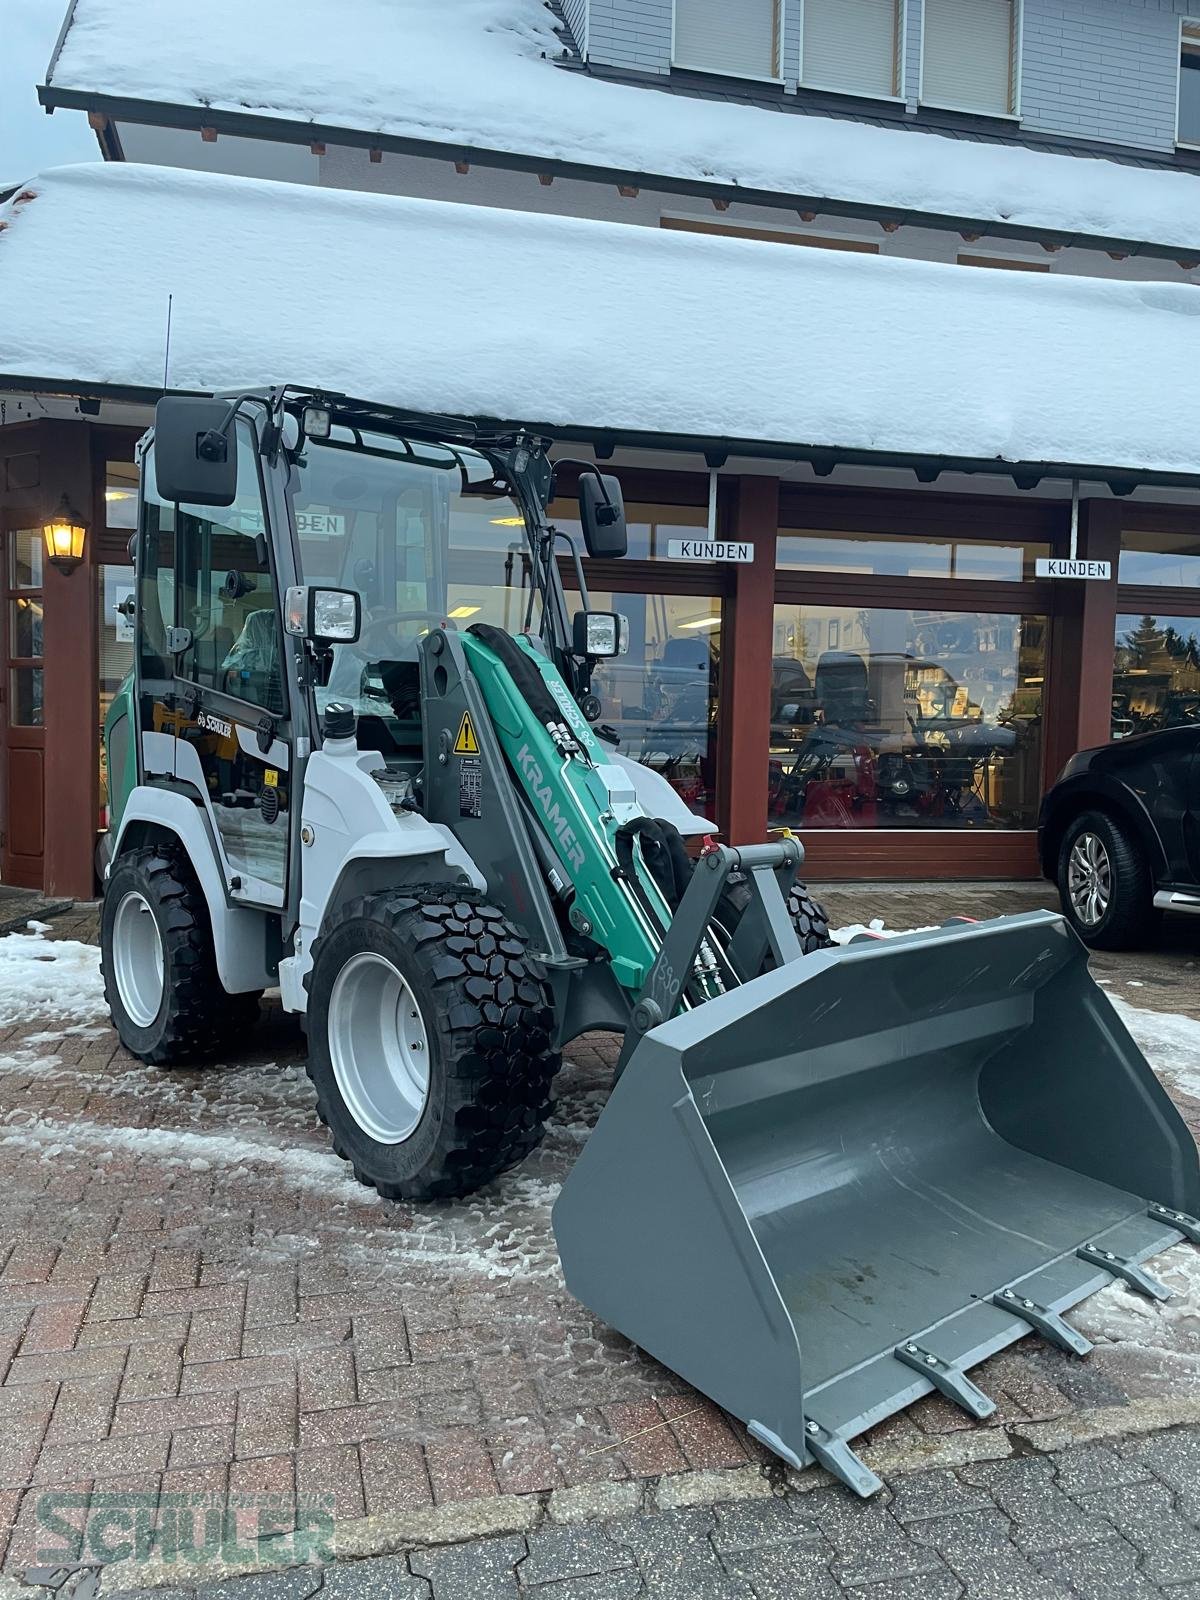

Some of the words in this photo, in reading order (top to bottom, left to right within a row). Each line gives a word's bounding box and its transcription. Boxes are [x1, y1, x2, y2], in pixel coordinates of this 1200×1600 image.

[681, 541, 748, 560] KUNDEN
[1048, 560, 1106, 577] KUNDEN
[545, 680, 585, 729] SCHULER
[206, 714, 232, 739] SCHULER
[516, 743, 586, 874] KRAMER
